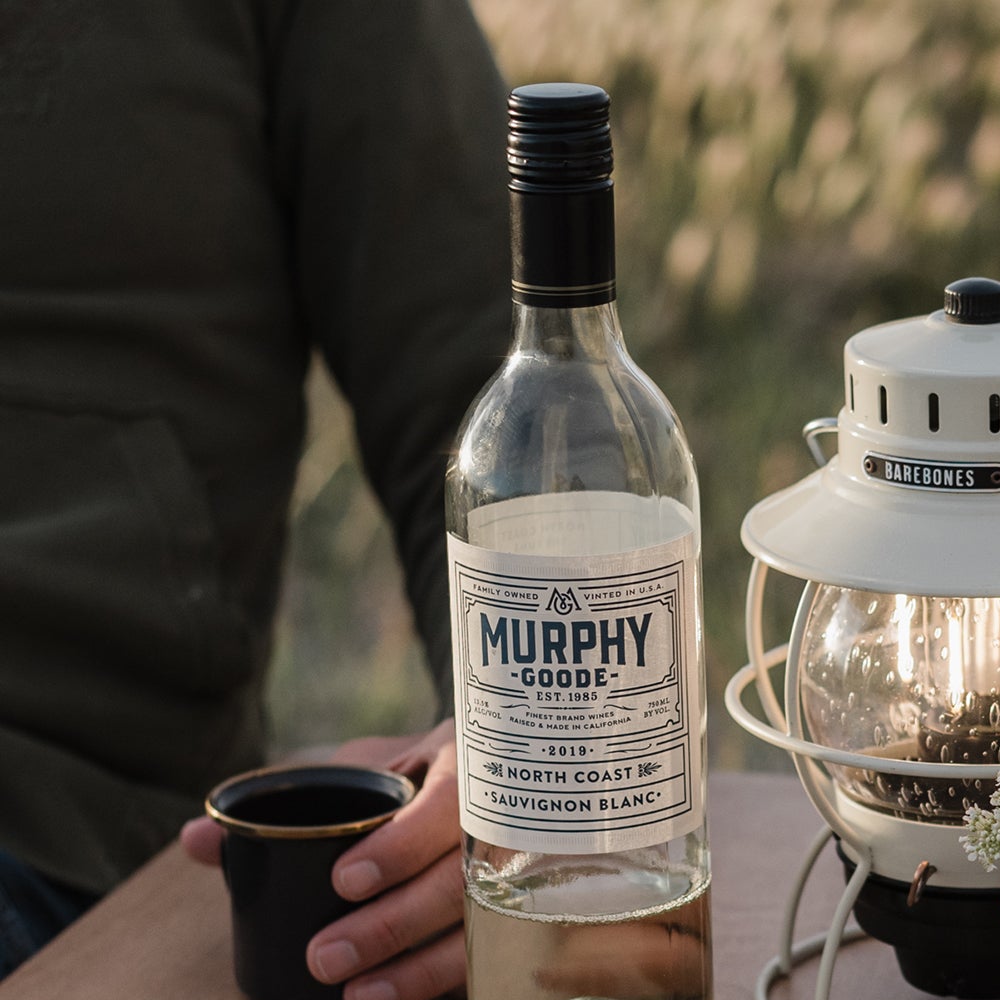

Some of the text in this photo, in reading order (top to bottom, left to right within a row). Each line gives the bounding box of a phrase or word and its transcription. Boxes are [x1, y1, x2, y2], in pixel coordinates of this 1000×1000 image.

[884, 461, 975, 487] BAREBONES
[473, 583, 539, 601] FAMILY OWNED
[584, 583, 665, 600] VINTED IN U.S.A.
[480, 612, 652, 667] MURPHY
[536, 691, 598, 701] EST. 1985
[509, 716, 535, 728] RAISED
[583, 716, 632, 730] CALIFORNIA
[526, 712, 553, 720] FINEST
[588, 711, 615, 720] WINES
[507, 766, 633, 784] NORTH COAST
